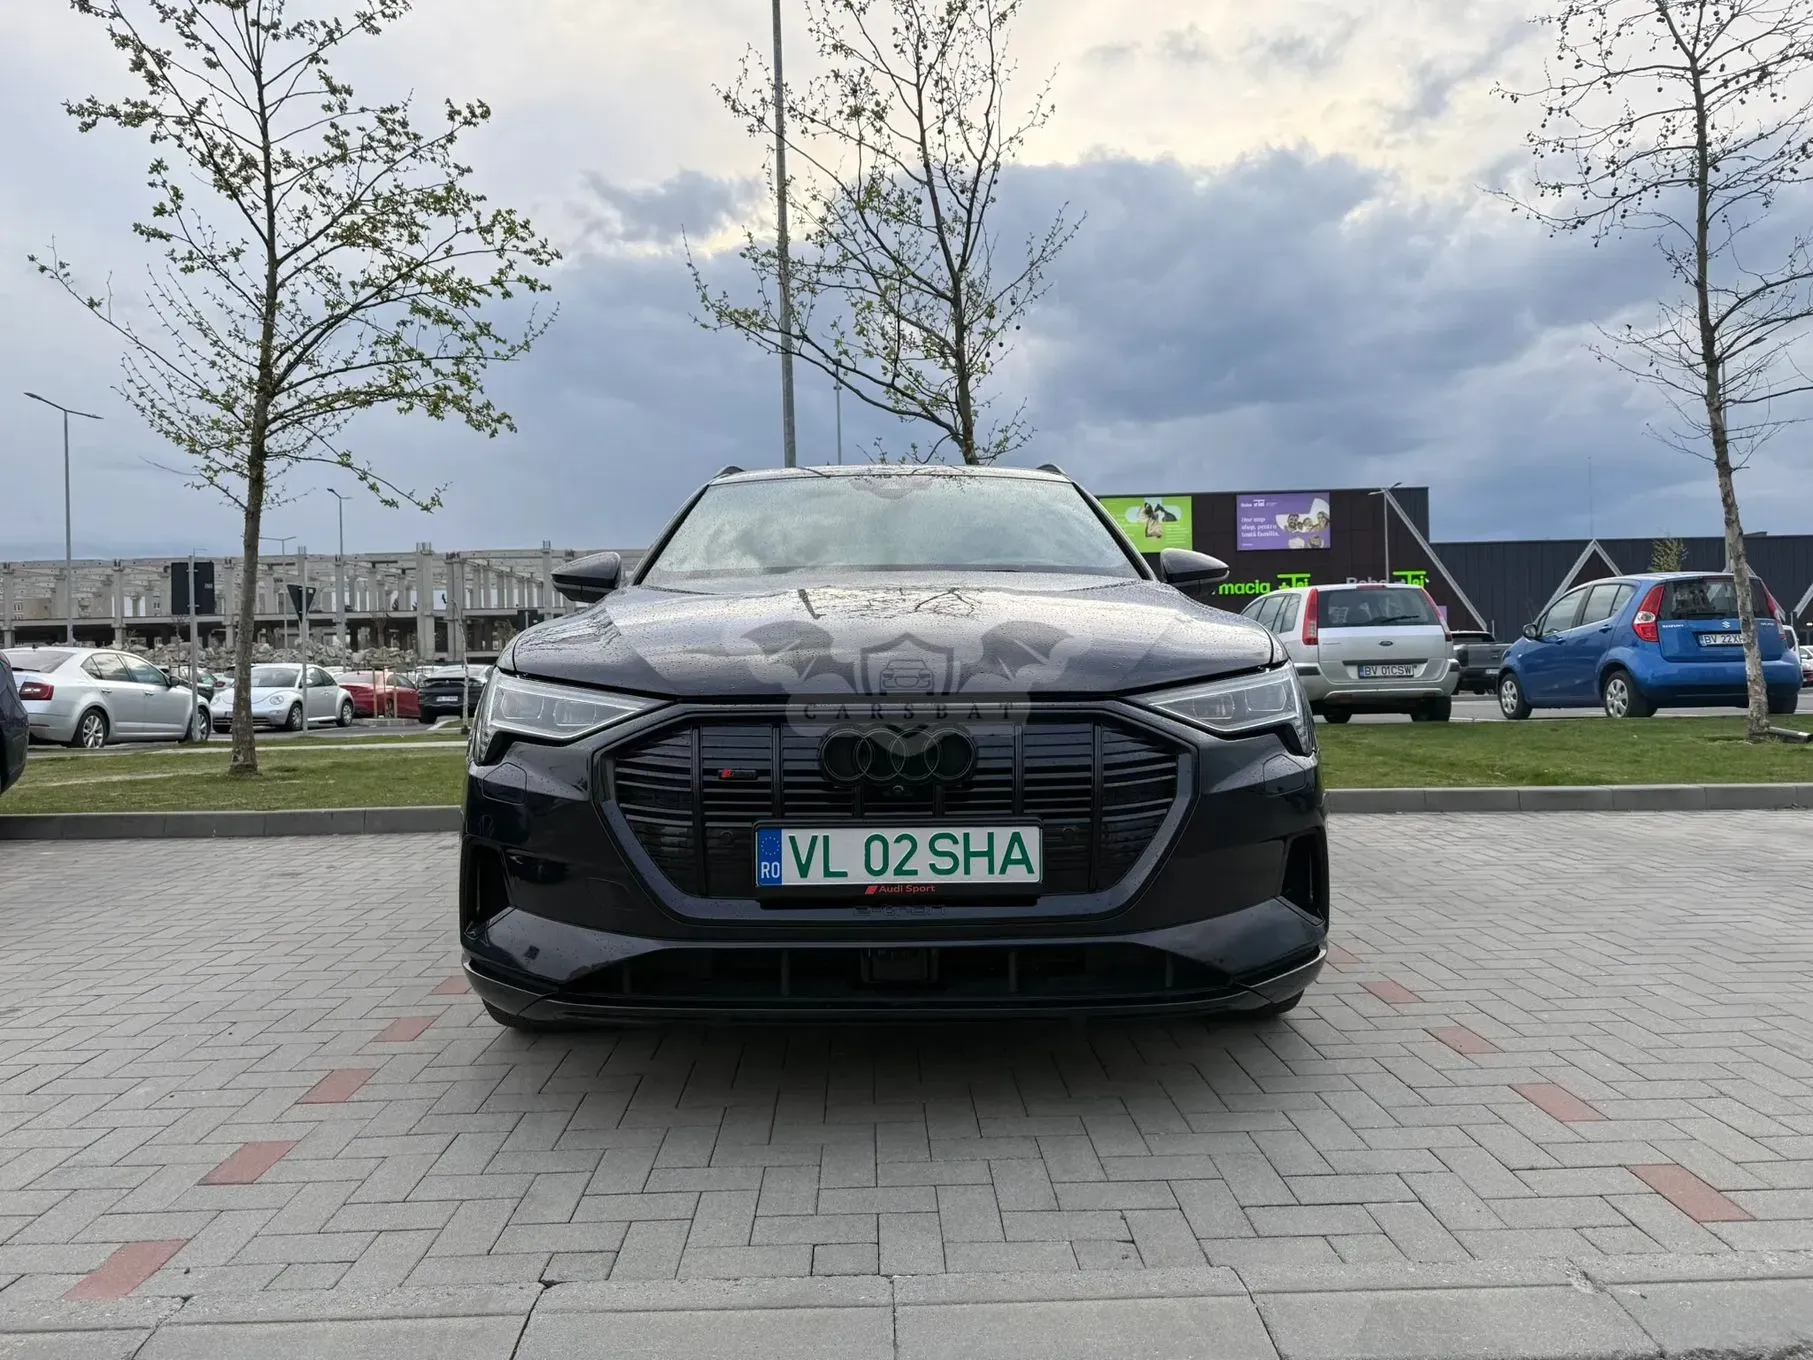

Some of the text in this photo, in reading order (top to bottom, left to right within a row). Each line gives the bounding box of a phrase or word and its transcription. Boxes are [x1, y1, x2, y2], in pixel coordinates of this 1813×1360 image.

[1703, 635, 1718, 644] BV
[1365, 665, 1378, 675] BV
[788, 831, 1036, 879] VL 02 SHA
[761, 861, 780, 879] RO
[879, 884, 936, 894] Audi Sport
